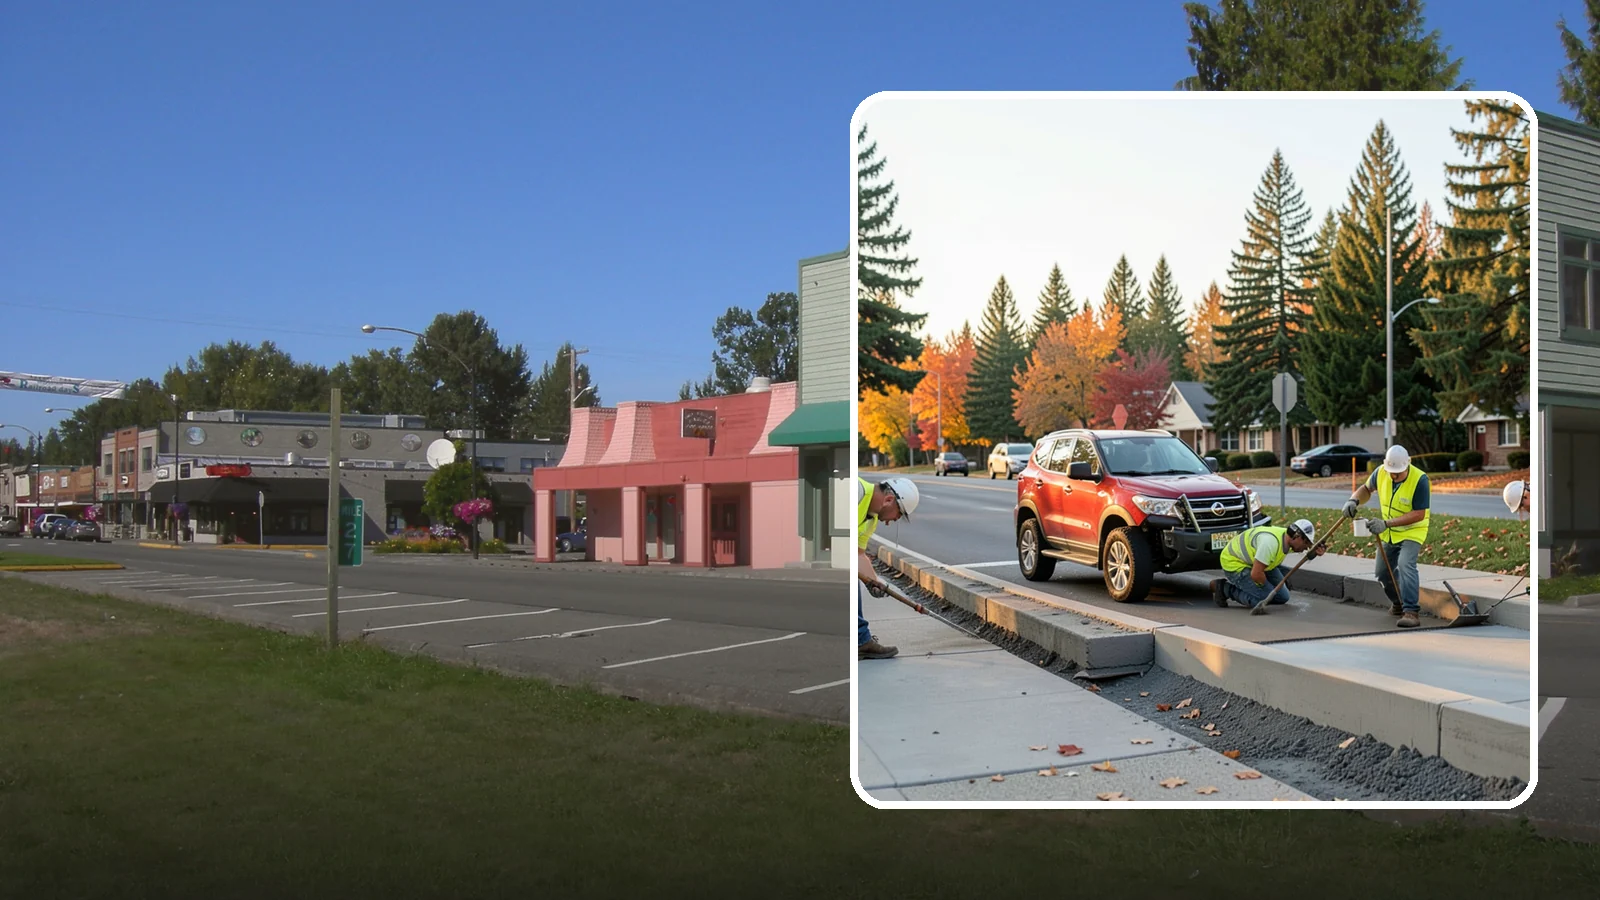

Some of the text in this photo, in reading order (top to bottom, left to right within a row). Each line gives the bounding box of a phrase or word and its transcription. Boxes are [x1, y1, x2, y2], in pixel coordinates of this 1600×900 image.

[20, 379, 57, 392] Railroad
[341, 505, 362, 517] MILE
[344, 522, 357, 539] 2
[344, 543, 356, 560] 7
